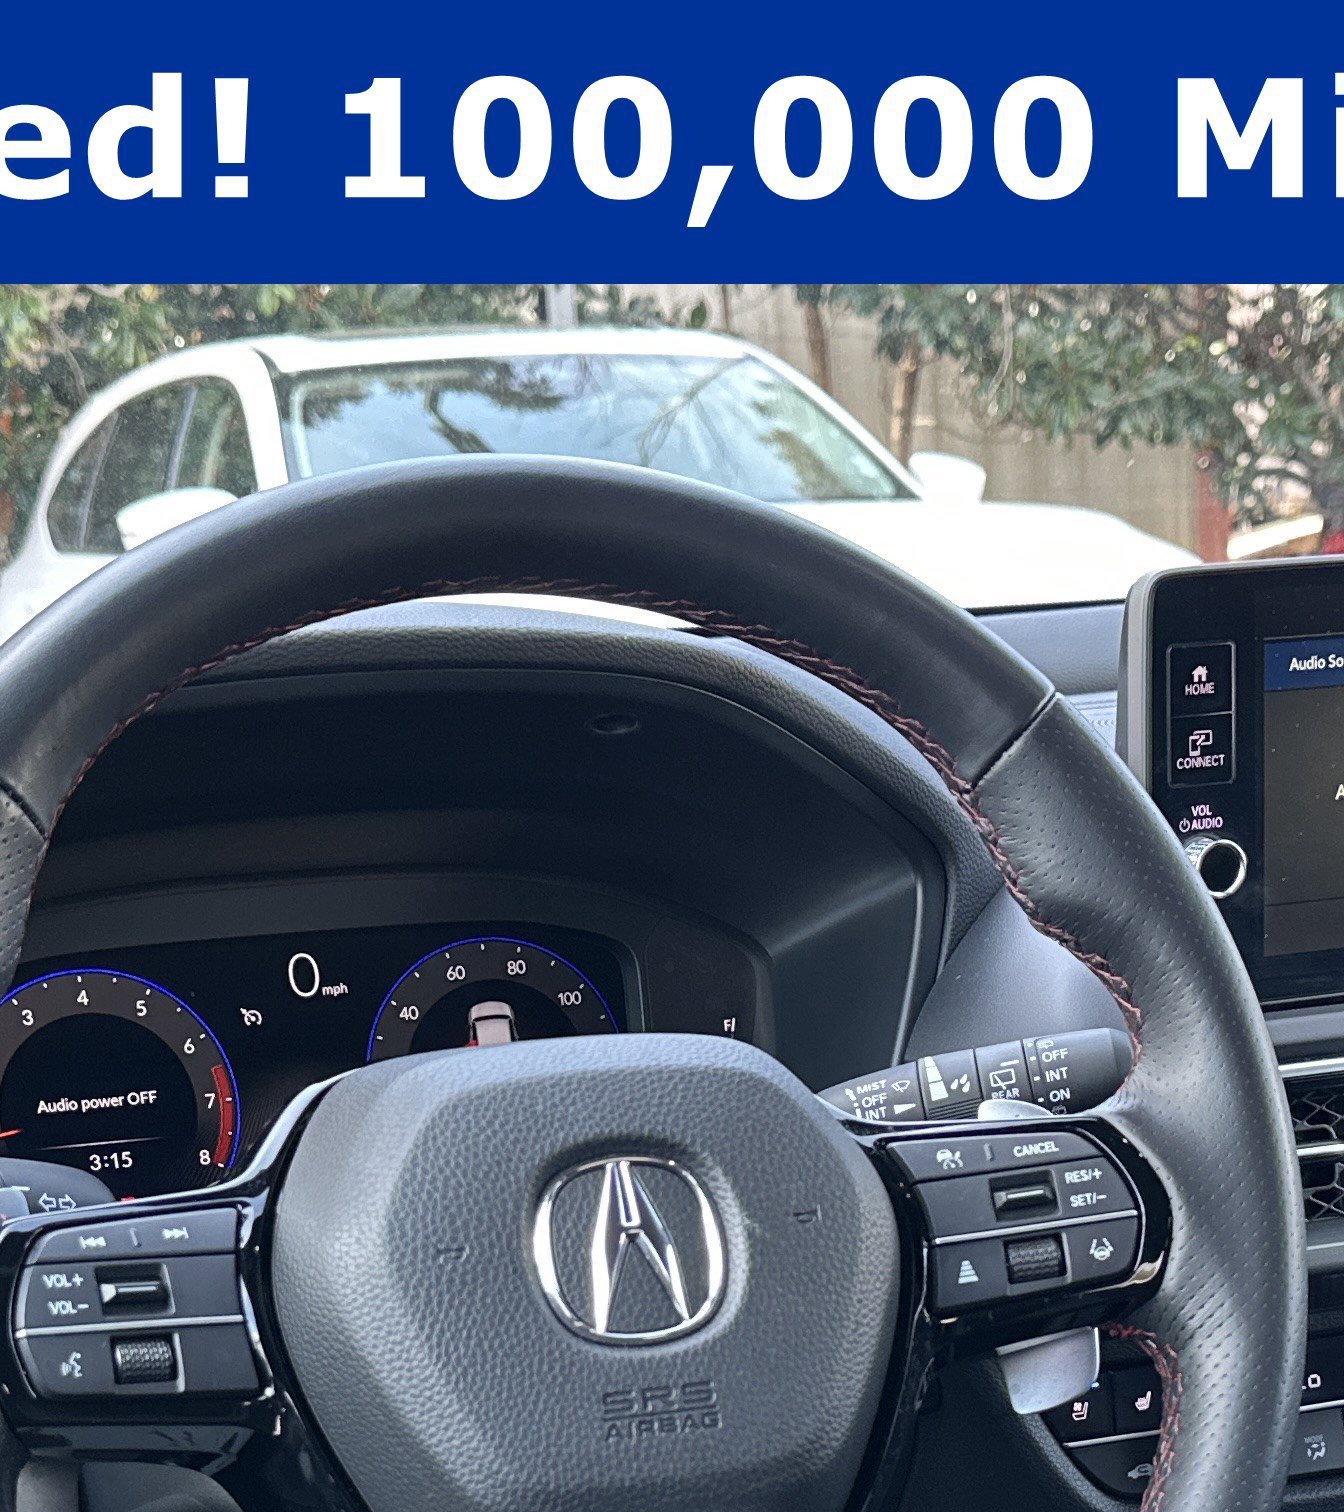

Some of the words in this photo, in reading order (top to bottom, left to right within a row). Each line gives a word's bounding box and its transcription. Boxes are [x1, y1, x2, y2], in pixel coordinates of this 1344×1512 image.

[1288, 655, 1326, 671] Audio
[1185, 682, 1215, 695] HOME
[1177, 754, 1225, 769] CONNECT
[1191, 804, 1213, 816] VOL
[1191, 816, 1223, 830] AUDIO
[288, 952, 320, 998] 0
[322, 982, 349, 997] mph
[446, 965, 466, 982] 60
[506, 959, 527, 976] 80
[76, 989, 89, 1006] 4
[557, 990, 582, 1007] 100
[136, 1000, 148, 1016] 5
[399, 1005, 419, 1021] 40
[22, 1009, 34, 1026] 3
[183, 1038, 195, 1054] 6
[1041, 1048, 1068, 1063] OFF
[1045, 1067, 1068, 1082] INT
[856, 1079, 887, 1094] MIST
[991, 1087, 1020, 1101] REAR
[37, 1097, 78, 1115] Audio
[81, 1097, 124, 1114] power
[127, 1090, 158, 1105] OFF
[204, 1092, 216, 1109] 7
[861, 1093, 887, 1107] OFF
[1049, 1088, 1071, 1102] ON
[199, 1150, 211, 1165] 8
[1013, 1141, 1059, 1158] CANCEL
[89, 1151, 133, 1171] 3:15
[602, 1379, 717, 1416] SRS
[604, 1411, 723, 1442] AIRBAG
